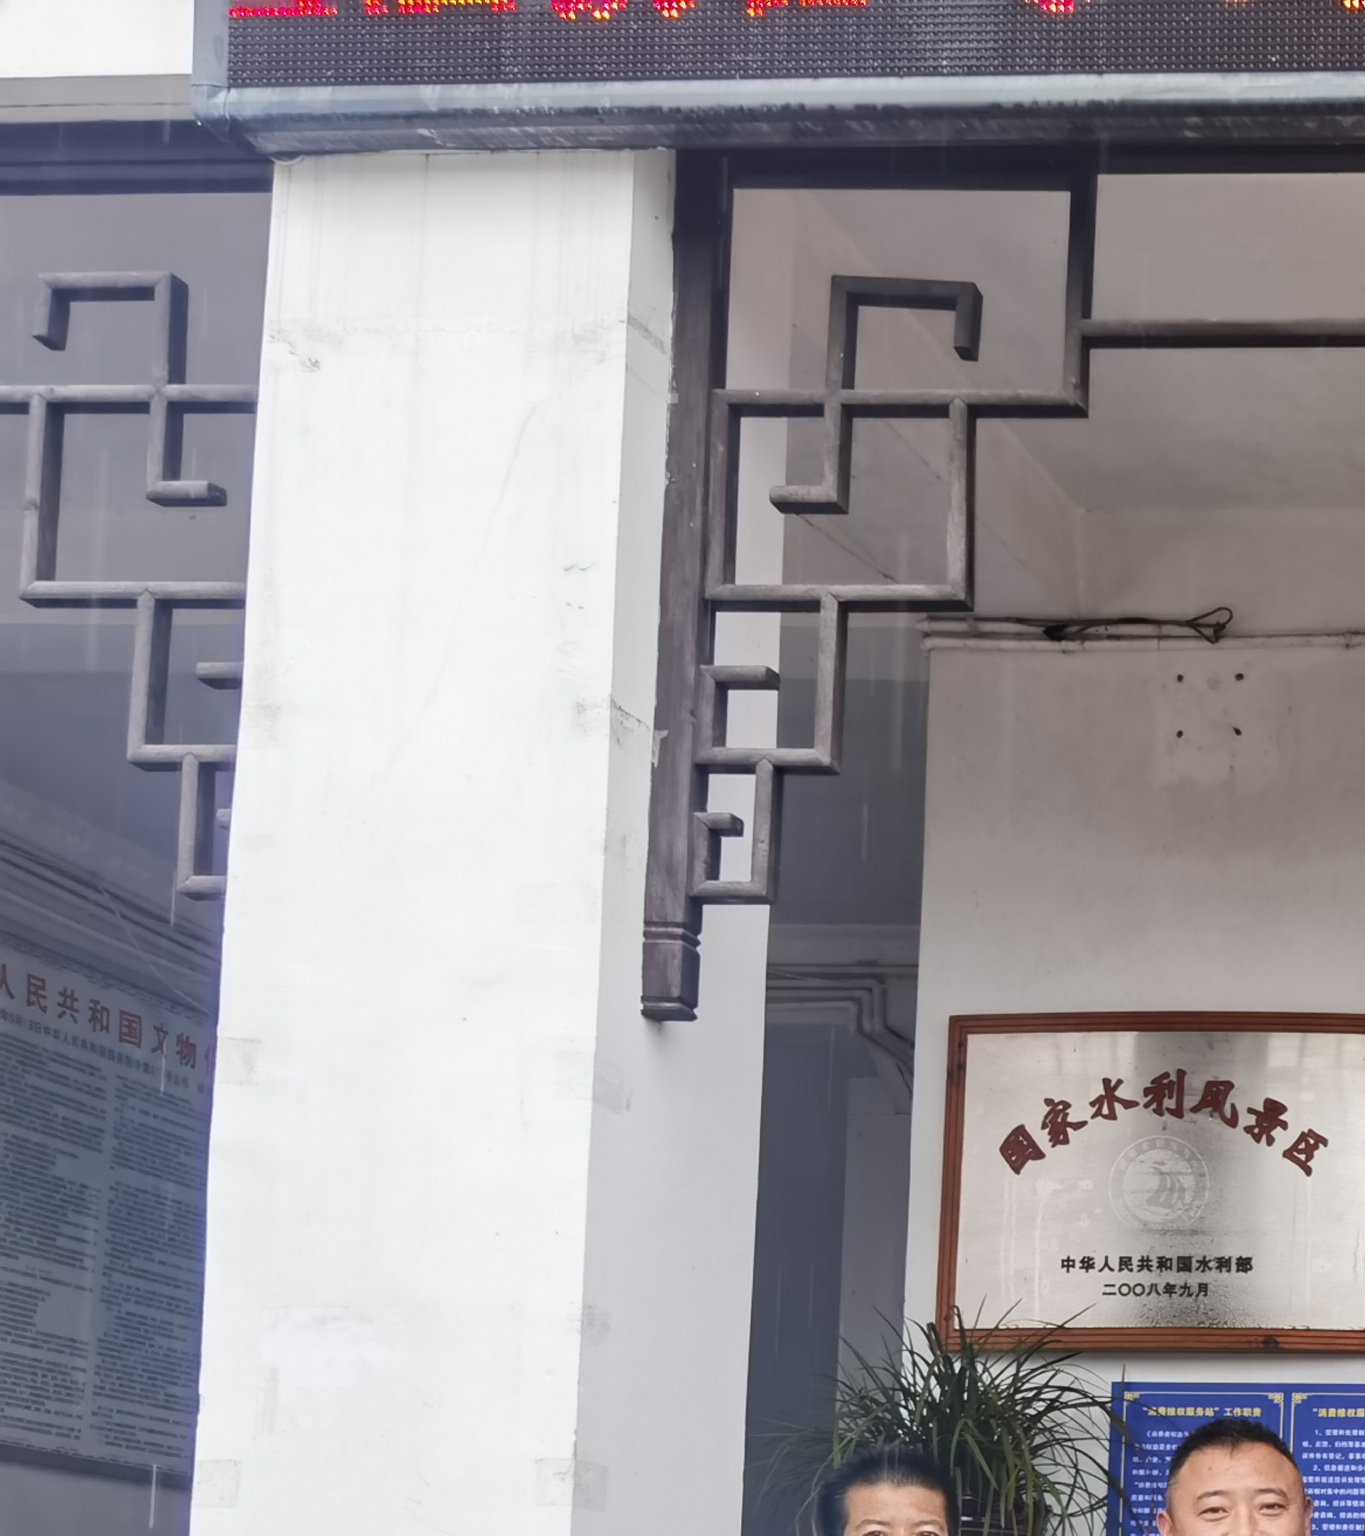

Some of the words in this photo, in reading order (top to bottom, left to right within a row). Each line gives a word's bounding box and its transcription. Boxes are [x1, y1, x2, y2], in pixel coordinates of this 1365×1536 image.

[999, 1069, 1329, 1176] 国家水利风景区
[1060, 1254, 1254, 1274] 中华人民共和国水利部
